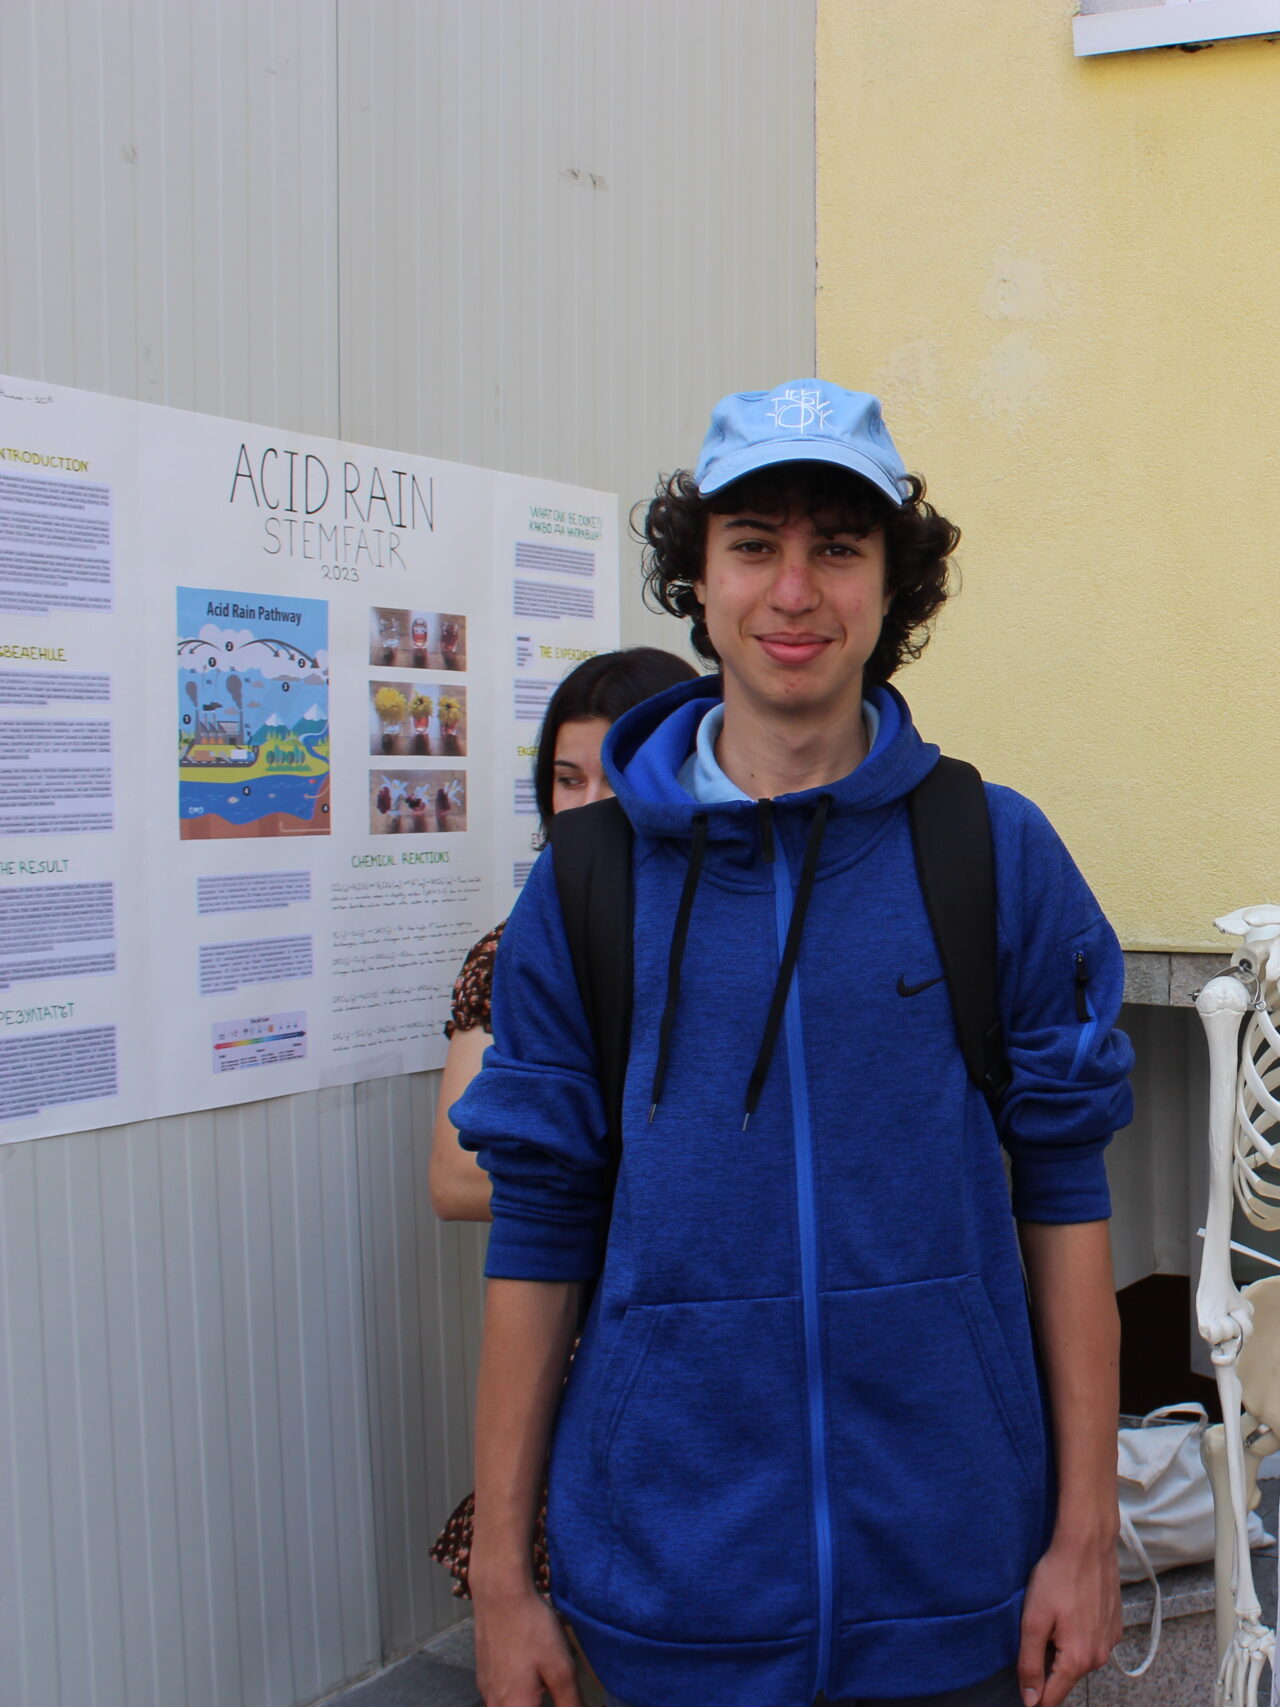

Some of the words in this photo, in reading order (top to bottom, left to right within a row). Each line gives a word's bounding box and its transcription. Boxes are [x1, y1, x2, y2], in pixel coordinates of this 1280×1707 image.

[230, 443, 329, 515] ACID
[344, 462, 434, 533] RAIN
[321, 565, 360, 582] 2023
[207, 601, 230, 617] Acid
[232, 604, 256, 619] Rain
[258, 606, 302, 626] Pathway
[19, 859, 69, 875] RESULT
[352, 854, 397, 868] CHEMICAL
[402, 851, 450, 865] REACTIONS
